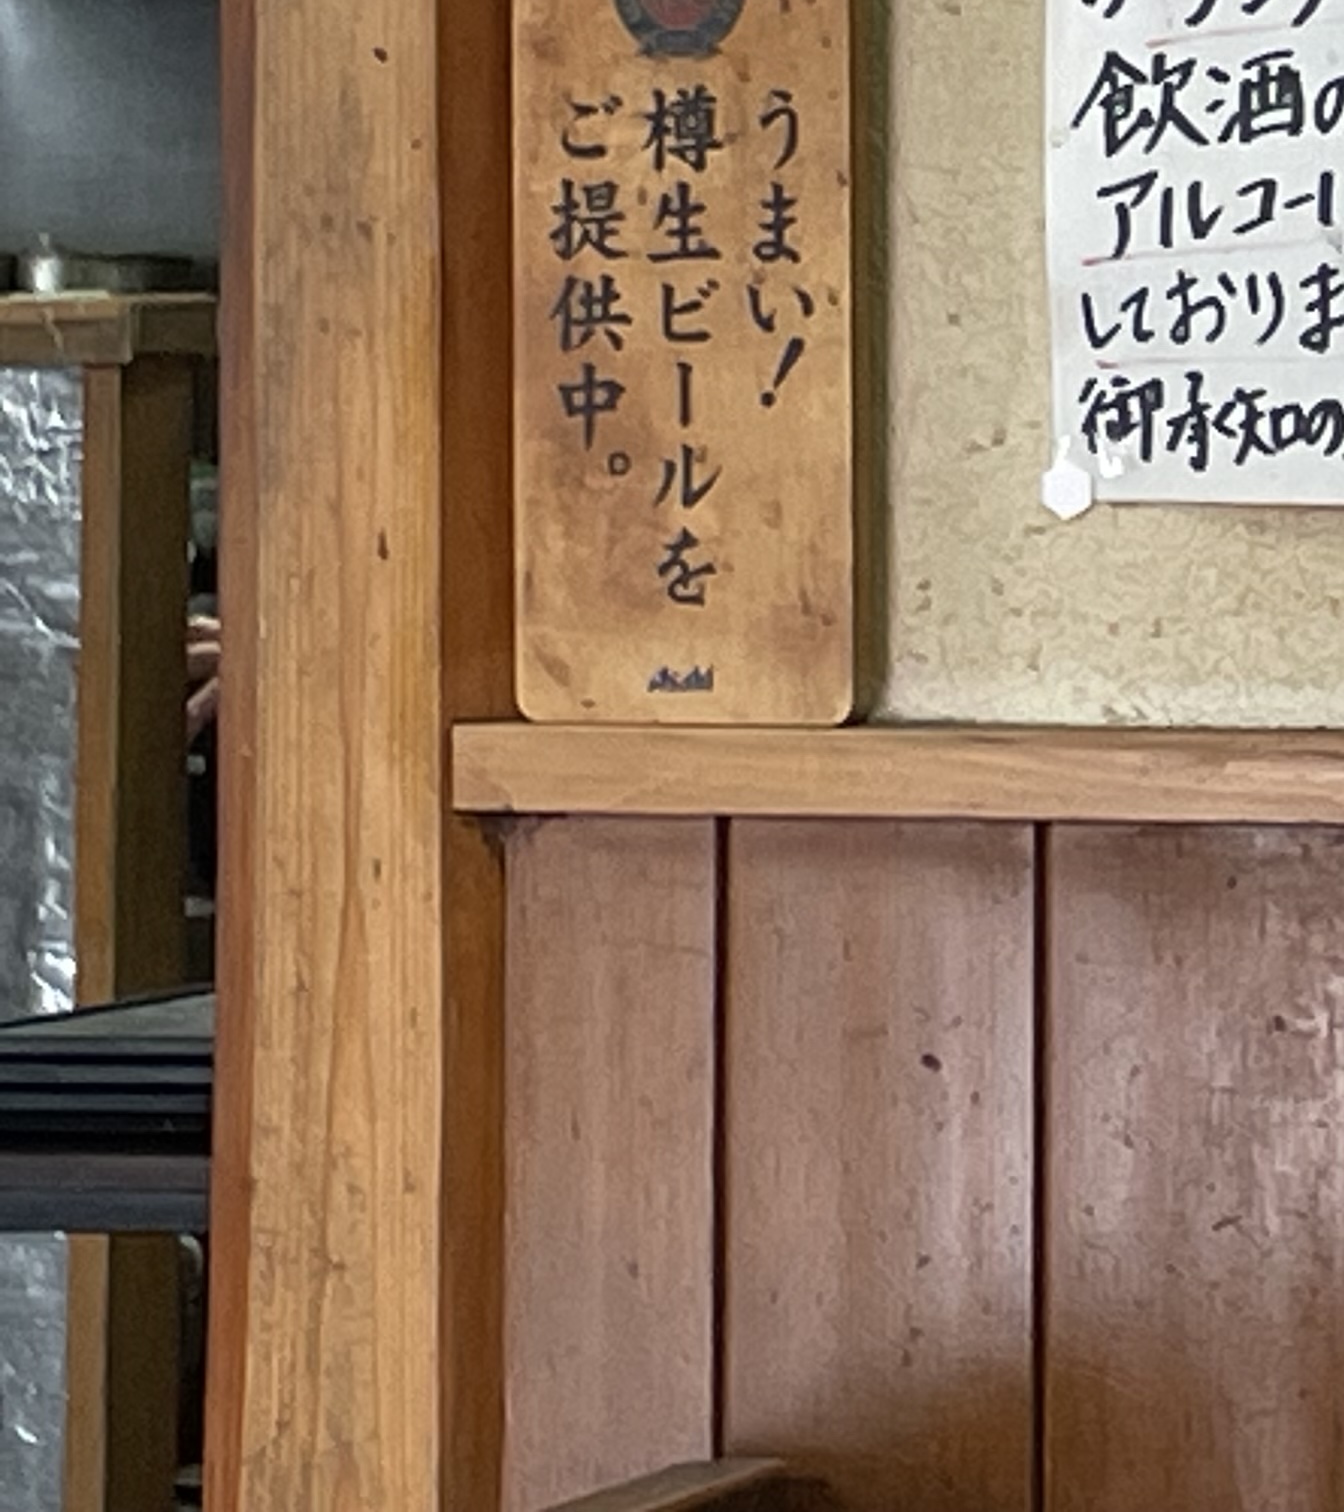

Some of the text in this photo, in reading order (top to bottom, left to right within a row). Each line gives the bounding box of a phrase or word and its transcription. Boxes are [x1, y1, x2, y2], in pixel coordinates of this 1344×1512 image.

[548, 93, 633, 477] ご提供中。
[641, 83, 724, 608] 樽生ビールを
[746, 89, 815, 408] うまい!
